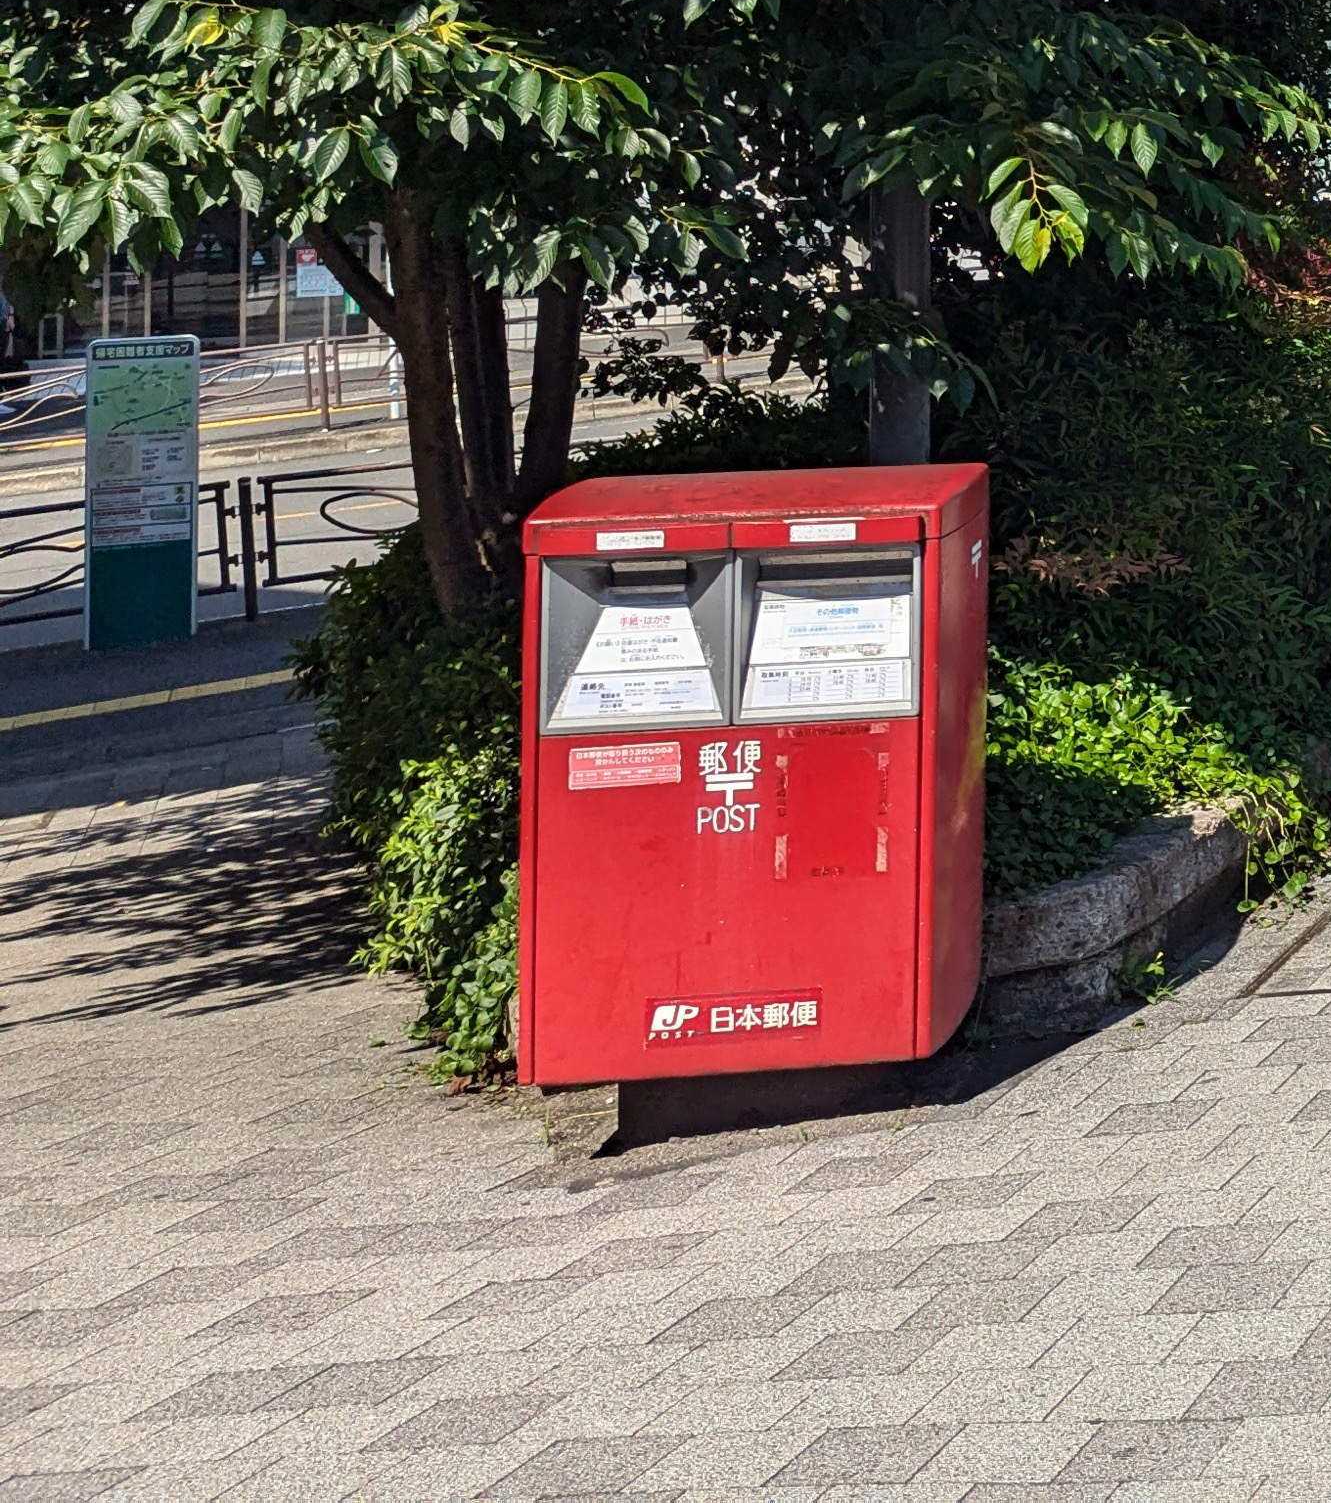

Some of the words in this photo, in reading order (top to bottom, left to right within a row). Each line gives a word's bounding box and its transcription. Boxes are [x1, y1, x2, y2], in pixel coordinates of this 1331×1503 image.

[619, 614, 672, 627] 手紙・はがき
[699, 740, 762, 776] 郵便
[696, 803, 761, 835] POST
[710, 1000, 818, 1033] 日本郵便
[648, 1029, 695, 1041] POST
